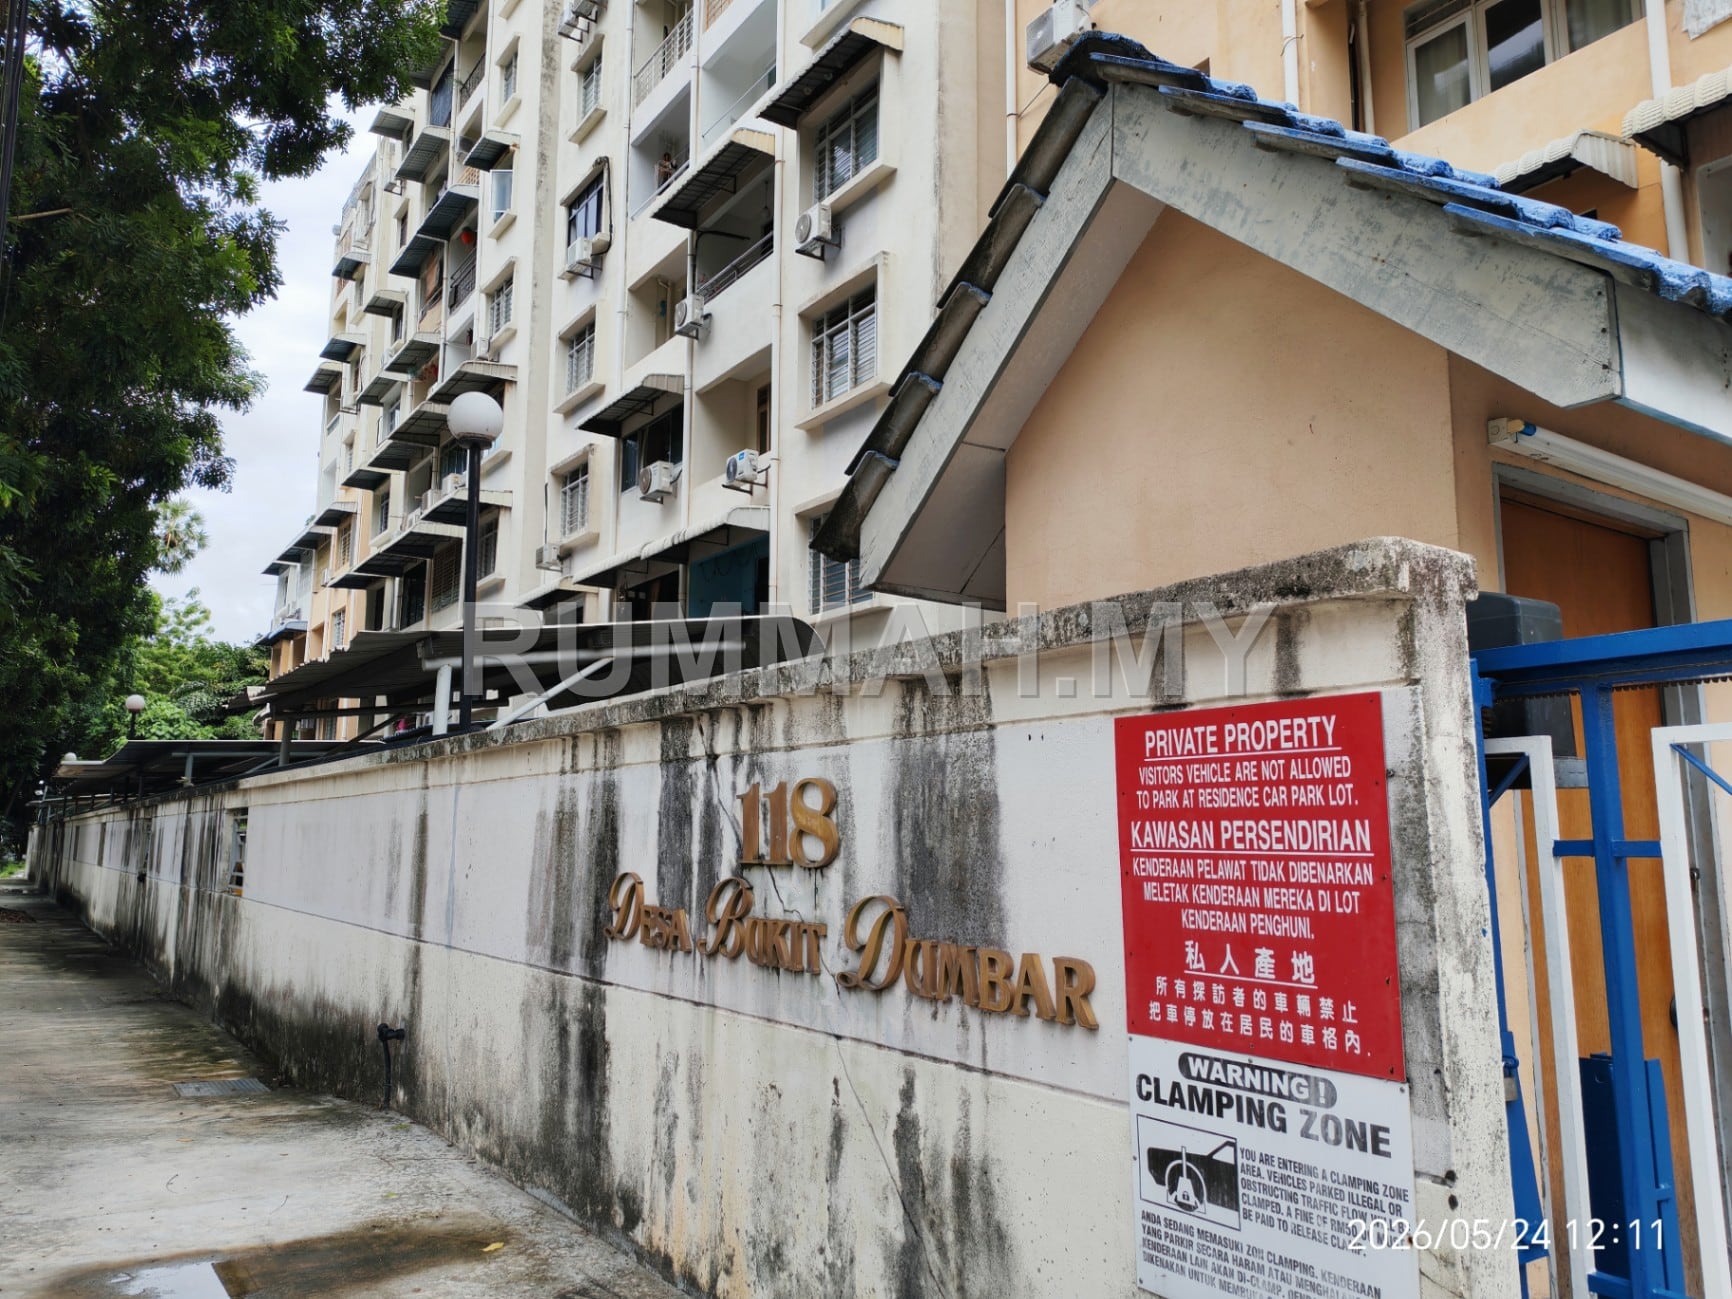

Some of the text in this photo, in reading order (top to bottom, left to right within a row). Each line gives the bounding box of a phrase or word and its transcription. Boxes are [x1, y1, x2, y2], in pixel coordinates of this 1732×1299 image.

[1145, 715, 1336, 757] PRIVATE PROPERTY
[1139, 756, 1351, 785] VISITORS VEHICLE ARE NOT ALLOWED
[1137, 784, 1358, 809] TO PARK AT RESIDENCE CAR PARK LOT.
[736, 777, 839, 868] 118
[1130, 819, 1371, 851] KAWASAN PERSENDIRIAN
[1133, 857, 1373, 885] KENDERAAN PELAWAT TIDAK DIBENARKAN
[1144, 882, 1360, 914] MELETAK KENDERAAN MEREKA DI LOT
[1181, 909, 1314, 939] KENDERAAN PENGHUNI.
[1184, 939, 1315, 984] 私人產地
[1136, 1074, 1391, 1158] CLAMPING ZONE
[1240, 1147, 1409, 1203] YOU ARE ENTERING A CLAMPING ZONE
[1240, 1162, 1403, 1217] AREA. VEHICLES PARKED ILLEGAL OR
[1241, 1177, 1298, 1204] OBSTRUCTING
[1301, 1194, 1338, 1216] TRAFFIC
[1341, 1205, 1367, 1223] FLOW
[1242, 1192, 1284, 1216] CLAMPED.
[1286, 1205, 1292, 1218] A
[1295, 1208, 1314, 1225] FINE
[1242, 1208, 1253, 1222] BE
[1255, 1211, 1274, 1228] PAID
[1277, 1218, 1288, 1232] TO
[1291, 1222, 1328, 1245] RELEASE
[1142, 1210, 1161, 1226] ANDA
[1164, 1217, 1194, 1237] SEDANG
[1197, 1228, 1243, 1253] MEMASUKI
[1267, 1250, 1318, 1279] CLAMPING.
[1321, 1268, 1381, 1299] KENDERAAN
[1142, 1223, 1162, 1240] YANG
[1164, 1231, 1194, 1251] PARKIR
[1197, 1242, 1229, 1263] SECARA
[1232, 1253, 1265, 1276] HARAM
[1268, 1266, 1292, 1286] ATAU
[1142, 1237, 1187, 1263] KENDERAAN
[1190, 1254, 1208, 1271] LAIN
[1211, 1262, 1234, 1279] AKAN
[1142, 1251, 1186, 1276] DIKENAKAN
[1188, 1267, 1216, 1289] UNTUK
